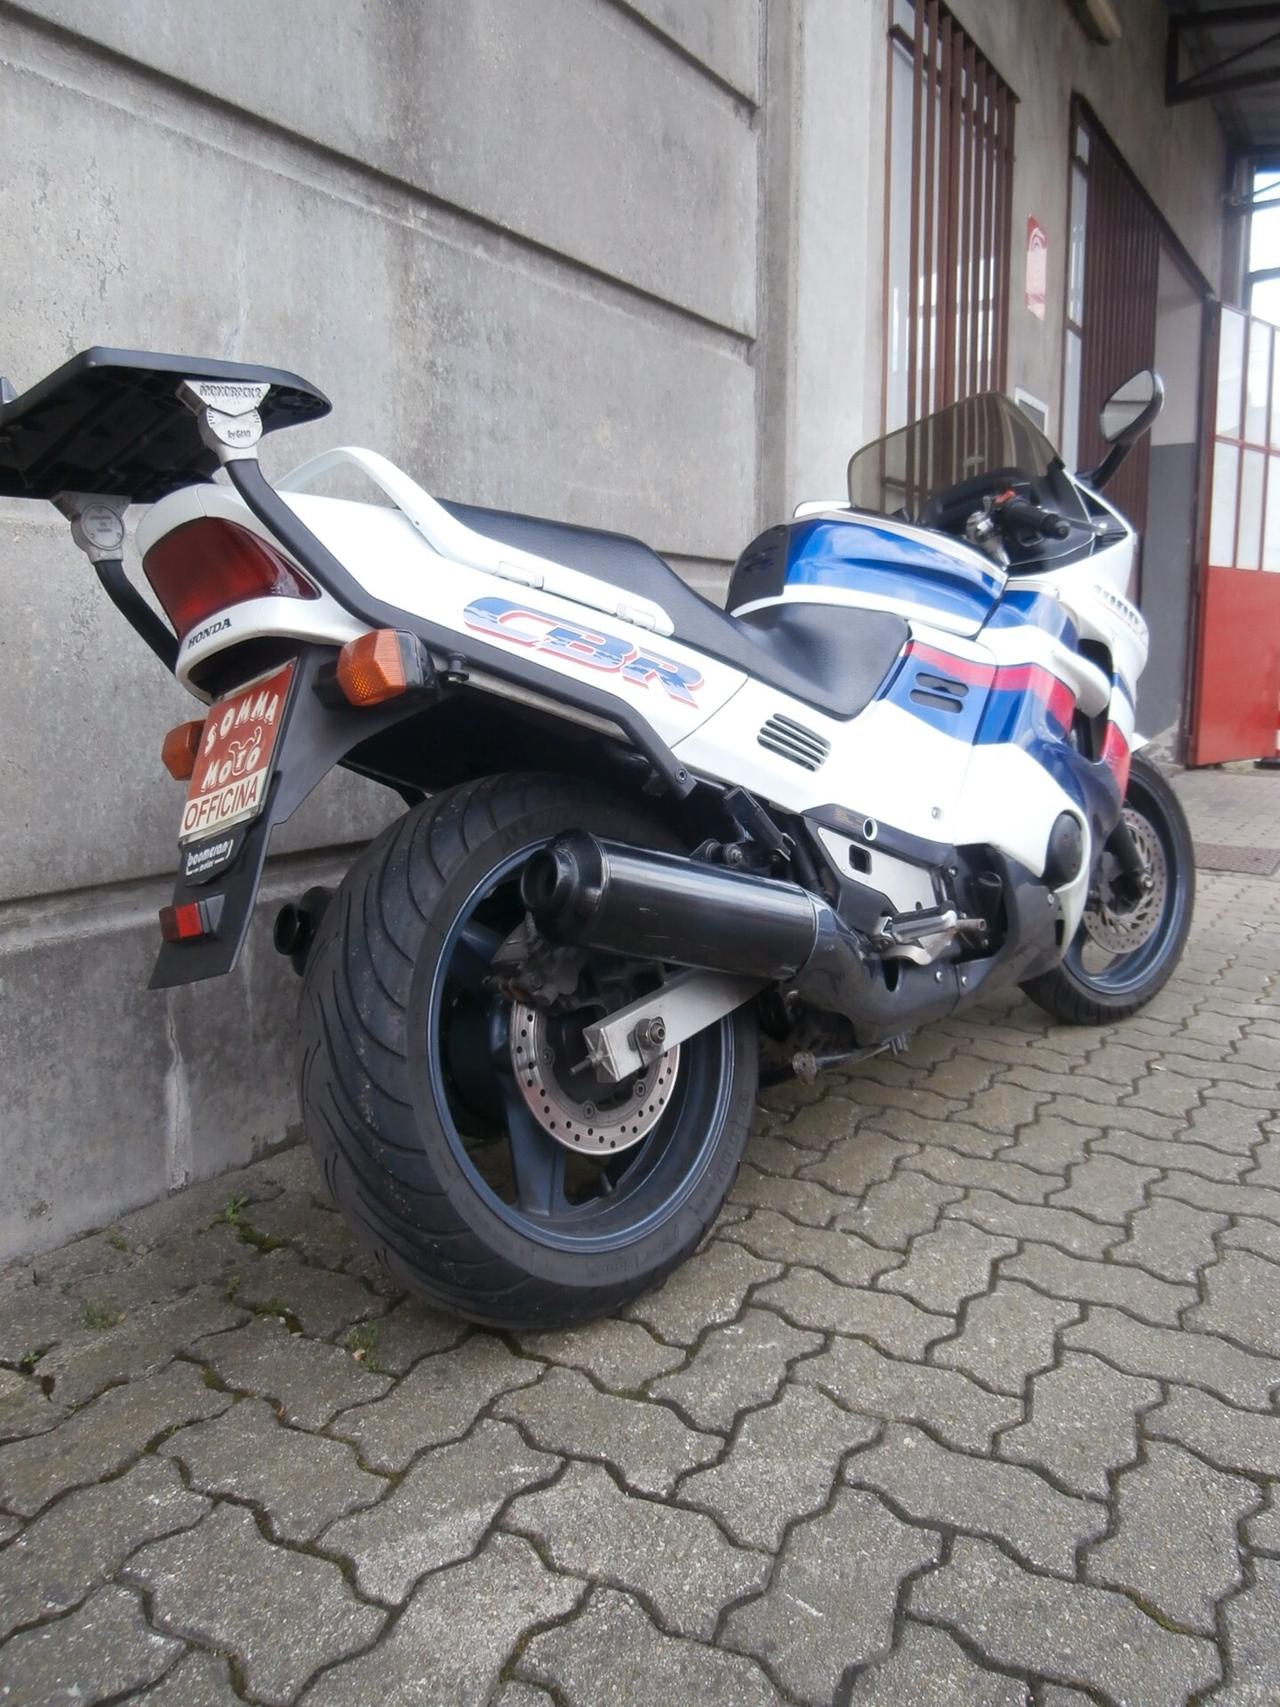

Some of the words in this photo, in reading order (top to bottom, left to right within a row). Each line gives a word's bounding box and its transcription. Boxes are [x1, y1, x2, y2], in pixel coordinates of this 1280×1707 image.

[187, 617, 232, 649] HONDA
[463, 596, 704, 709] CBR
[204, 690, 279, 757] SOMMA
[184, 776, 258, 831] OFFICINA
